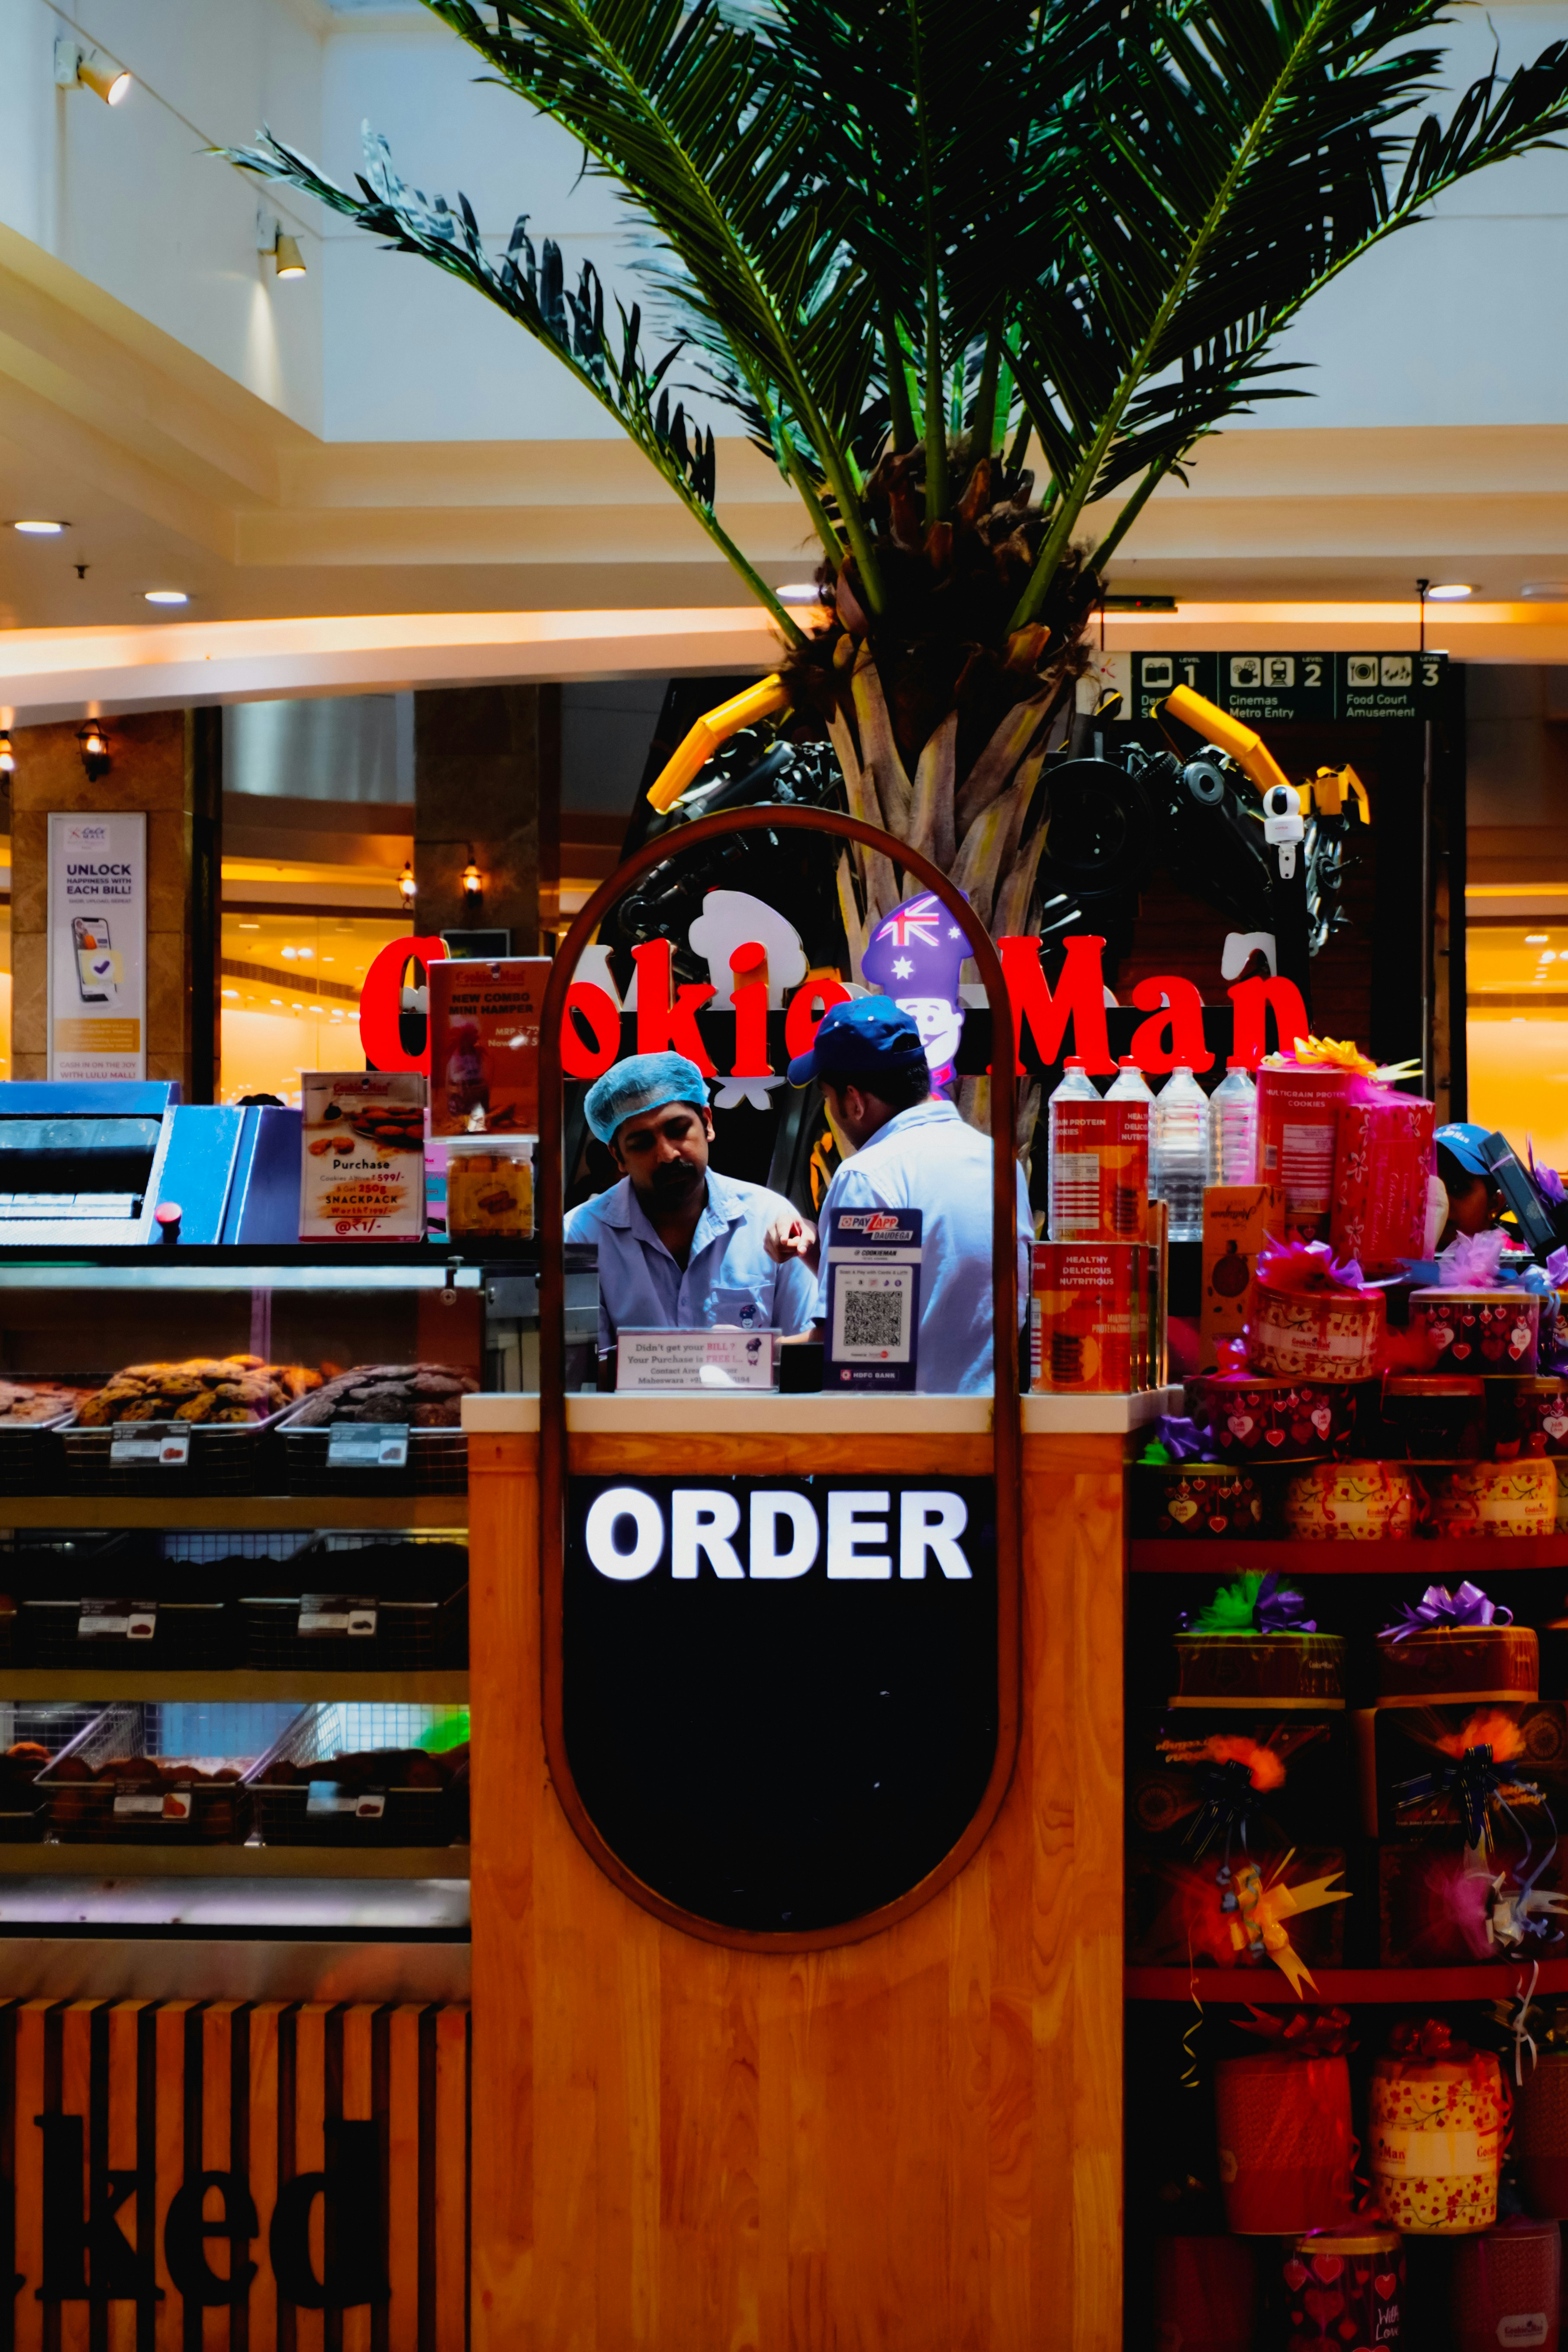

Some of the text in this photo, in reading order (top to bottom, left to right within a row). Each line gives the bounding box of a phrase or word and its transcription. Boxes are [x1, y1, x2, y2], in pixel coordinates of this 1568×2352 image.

[1184, 665, 1195, 687] 1
[1304, 664, 1322, 687] 2
[1422, 664, 1439, 686] 3
[1229, 695, 1278, 706] Cinemas
[1346, 694, 1407, 705] Food Court
[1229, 708, 1294, 719] Metro Entry
[1346, 707, 1415, 717] Amusement
[67, 864, 131, 876] UNLOCK
[67, 886, 131, 895] EACH BILL!
[452, 992, 530, 1003] NEW COMBO
[360, 935, 1313, 1078] Cokie Man
[449, 1004, 533, 1014] MINI HAMPER
[1266, 1089, 1314, 1098] MULTIGRAIN
[333, 1159, 390, 1169] Purchase
[358, 1184, 387, 1195] 250g
[325, 1195, 398, 1204] SNACKPACK
[666, 1344, 680, 1353] get
[1384, 2146, 1406, 2159] Man
[0, 2114, 392, 2310] ked
